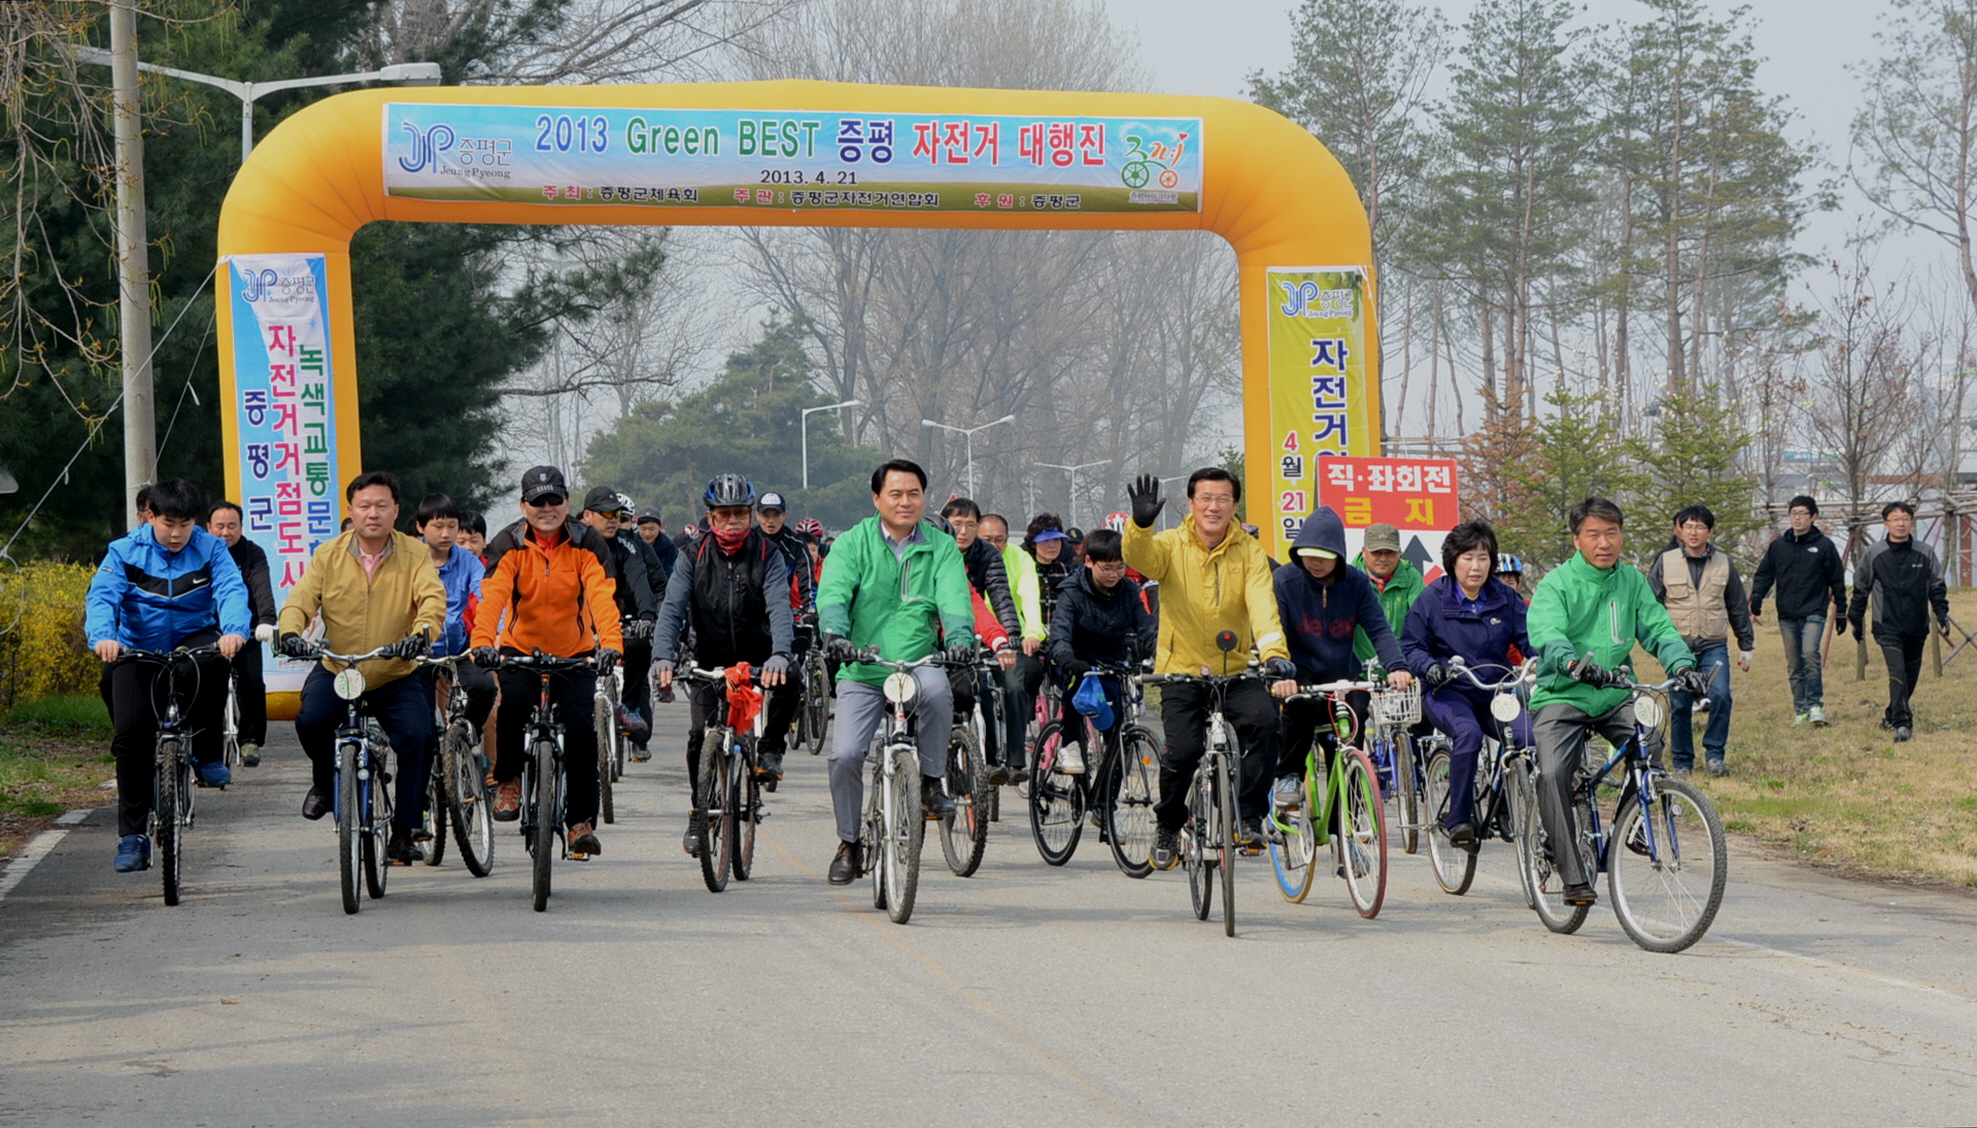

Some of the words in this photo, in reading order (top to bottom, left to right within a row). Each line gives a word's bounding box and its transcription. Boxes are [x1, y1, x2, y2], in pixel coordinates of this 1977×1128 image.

[536, 115, 609, 154] 2013
[627, 117, 719, 155] Green
[738, 120, 819, 158] BEST
[836, 118, 894, 163] 증평
[913, 121, 999, 166] 자전거
[1019, 123, 1105, 167] 대행진
[459, 138, 512, 167] 증평군
[837, 171, 858, 184] 21
[600, 186, 698, 202] 증평군체육회
[791, 190, 939, 207] 증평군자전거연합회
[1032, 193, 1080, 209] 증평군
[281, 275, 315, 295] 증평군
[1311, 339, 1349, 456] 자전거
[299, 344, 332, 557] 녹색교통문
